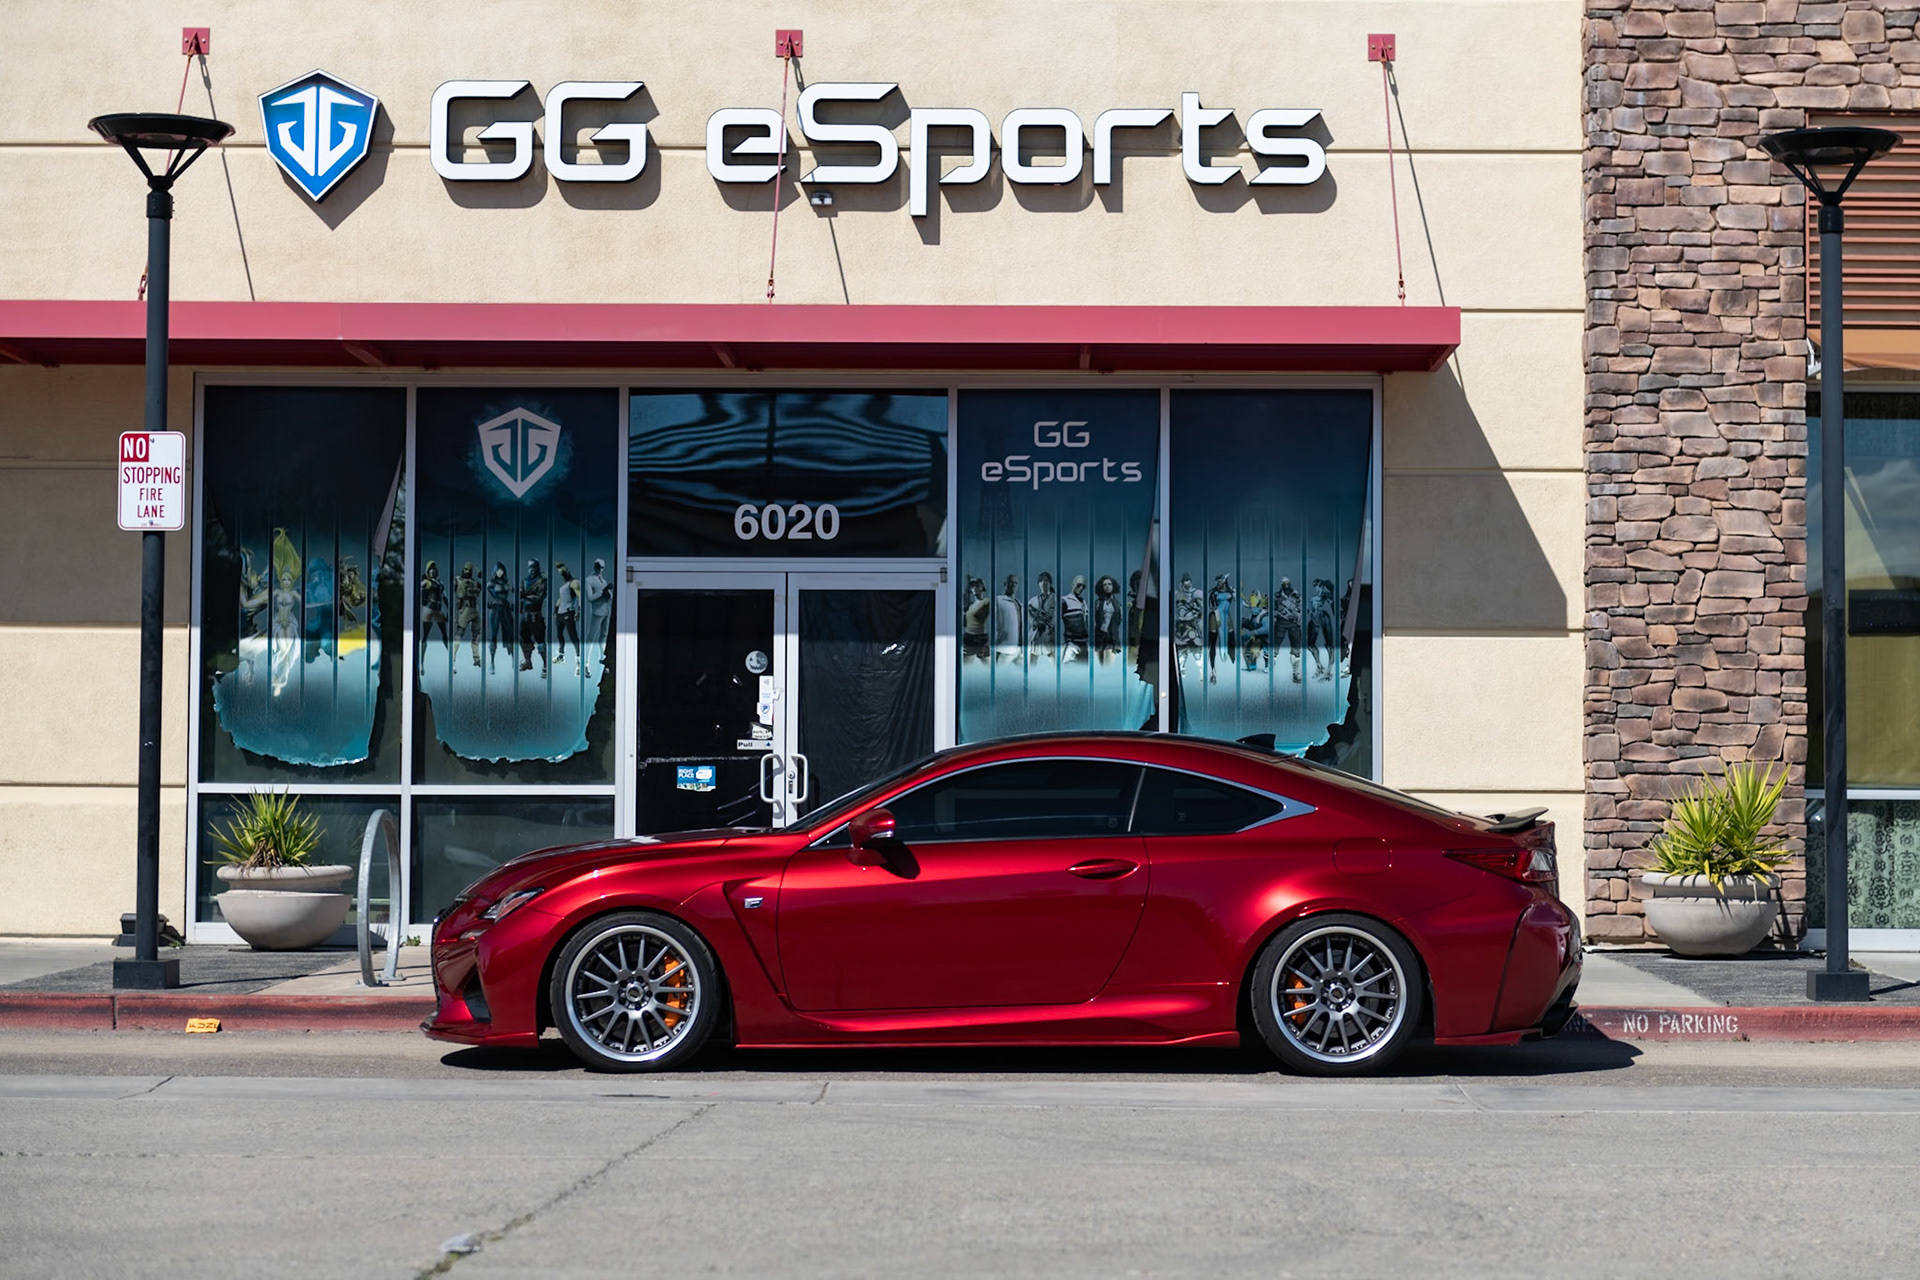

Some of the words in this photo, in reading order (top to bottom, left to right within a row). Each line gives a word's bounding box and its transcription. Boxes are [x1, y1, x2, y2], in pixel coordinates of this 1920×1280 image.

[430, 80, 647, 183] GG
[705, 82, 1328, 218] eSports
[1033, 421, 1090, 448] GG
[123, 437, 147, 459] NO
[122, 466, 181, 485] STOPPING
[981, 455, 1143, 491] eSports
[139, 488, 164, 501] FIRE
[137, 504, 166, 519] LANE
[734, 503, 840, 540] 6020
[1623, 1014, 1649, 1034] NO
[1658, 1014, 1739, 1034] PARKING
